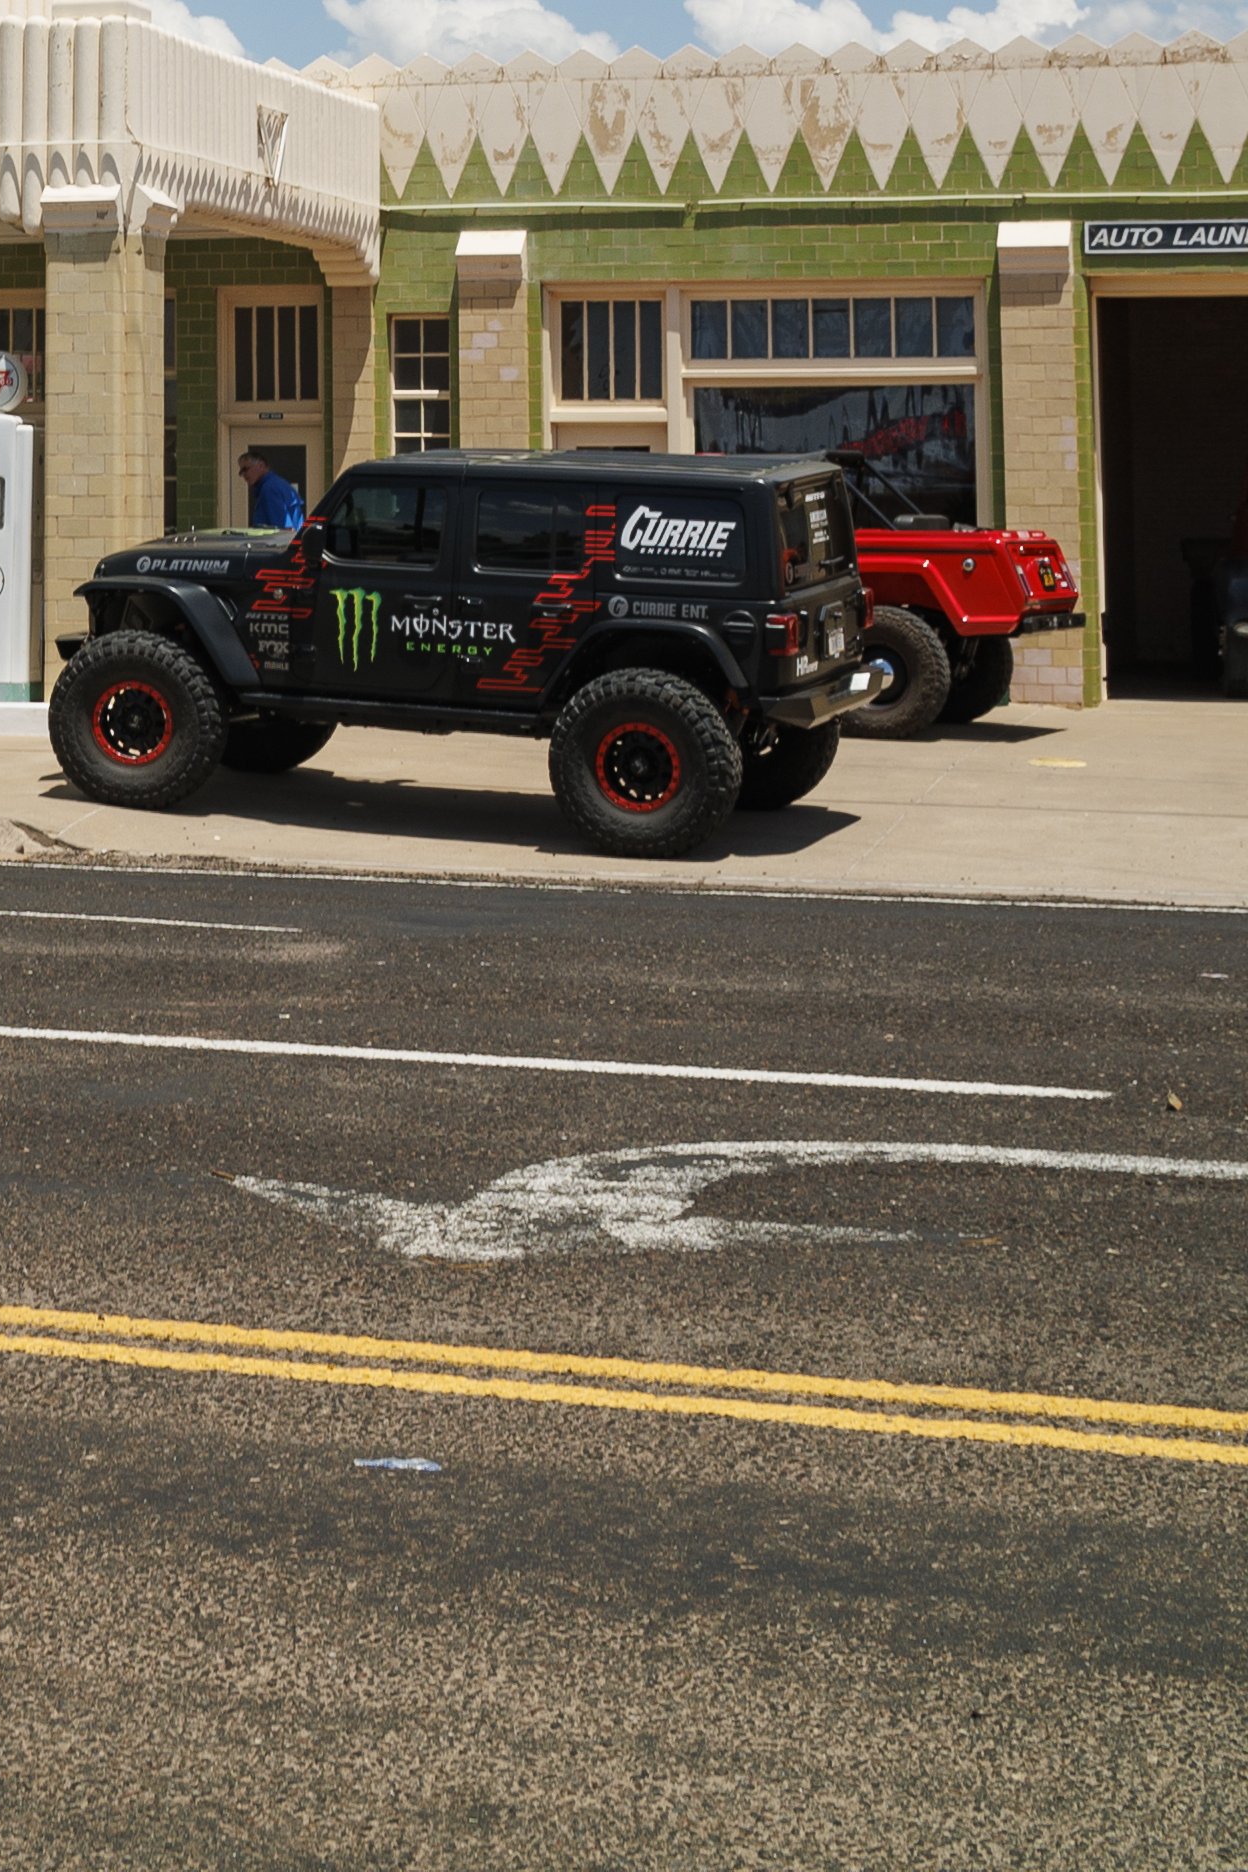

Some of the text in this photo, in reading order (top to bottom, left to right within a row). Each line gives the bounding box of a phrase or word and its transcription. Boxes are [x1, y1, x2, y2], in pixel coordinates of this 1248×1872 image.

[1091, 227, 1163, 247] AUTO
[620, 504, 737, 550] CURRIE
[151, 558, 230, 572] PLATINUM
[632, 601, 710, 620] CURRIE ENT.
[390, 613, 517, 644] MONSTER
[406, 641, 494, 657] ENERGY
